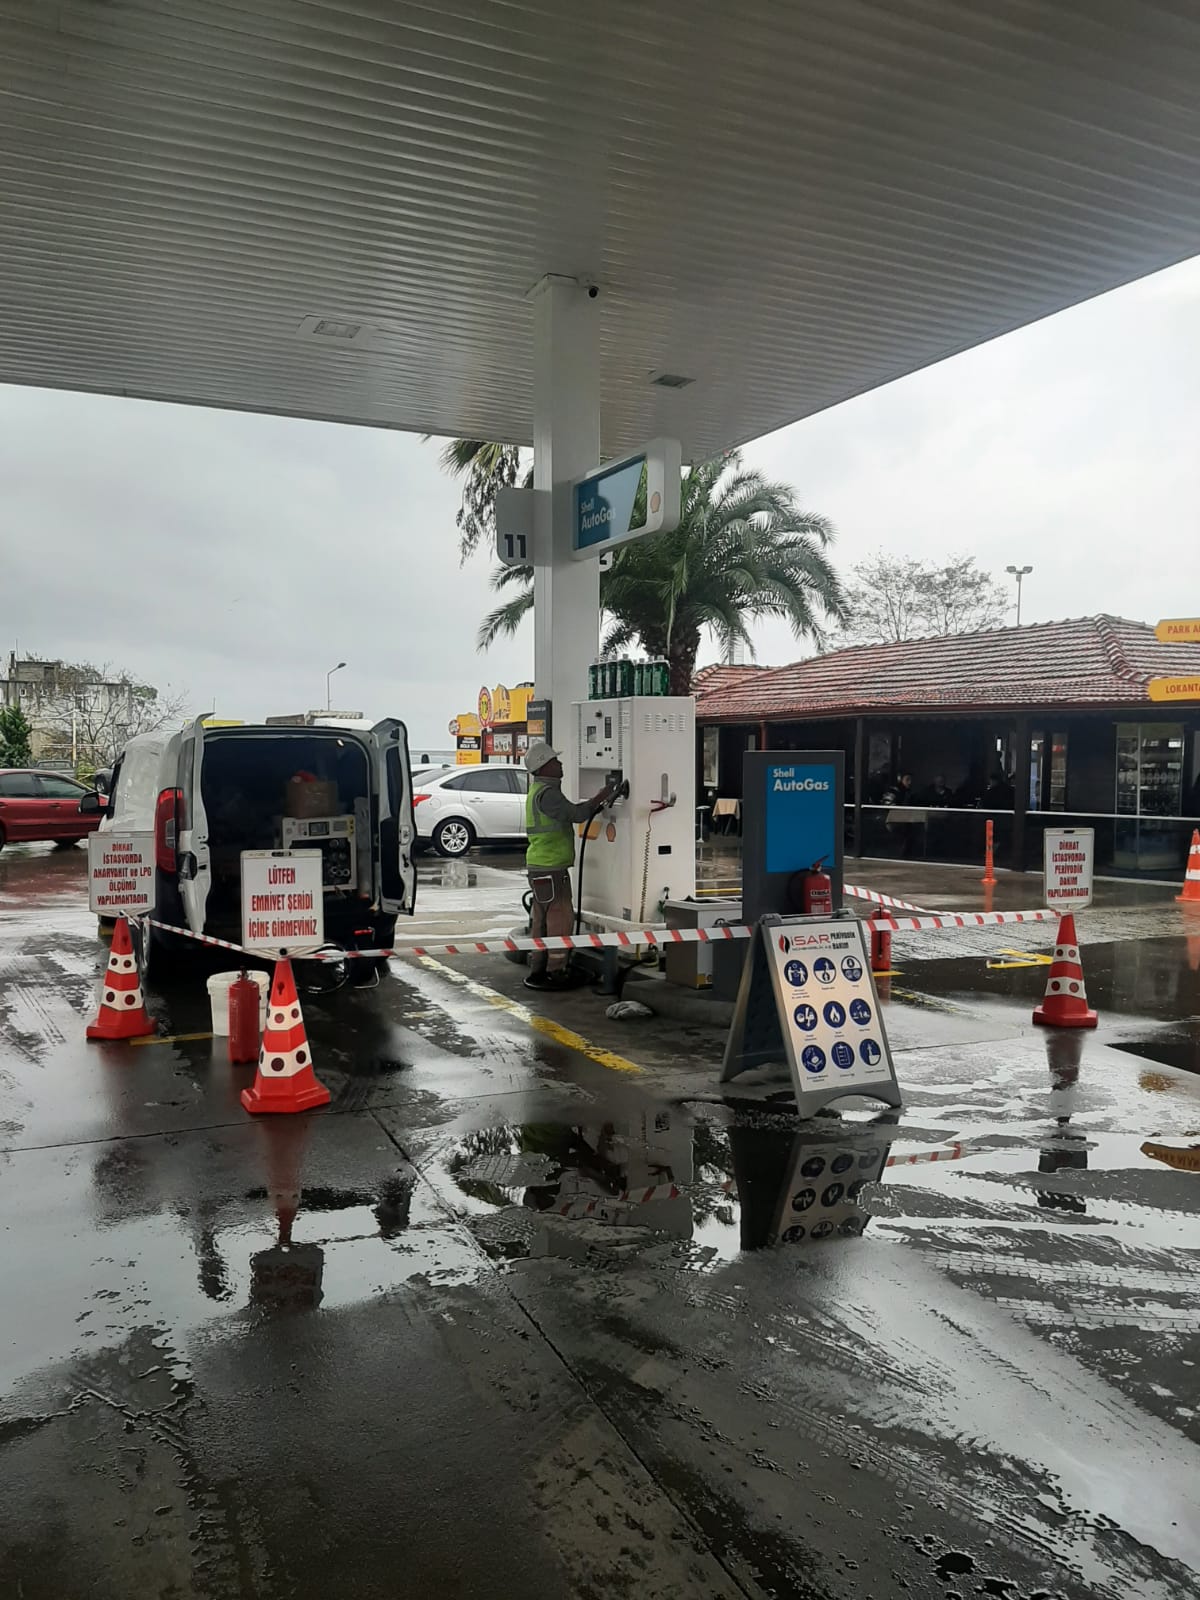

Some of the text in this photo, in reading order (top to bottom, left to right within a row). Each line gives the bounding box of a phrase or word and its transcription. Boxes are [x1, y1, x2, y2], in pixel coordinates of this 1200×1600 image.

[580, 498, 594, 514] Shell
[504, 534, 527, 559] 11
[1167, 625, 1190, 634] PARK
[773, 768, 795, 778] Shell
[773, 778, 829, 791] AutoGas
[140, 866, 151, 877] LPG
[268, 864, 296, 884] LÜTFEN
[252, 890, 313, 914] EMNİYET ŞERİDİ
[248, 917, 269, 941] İÇİNE
